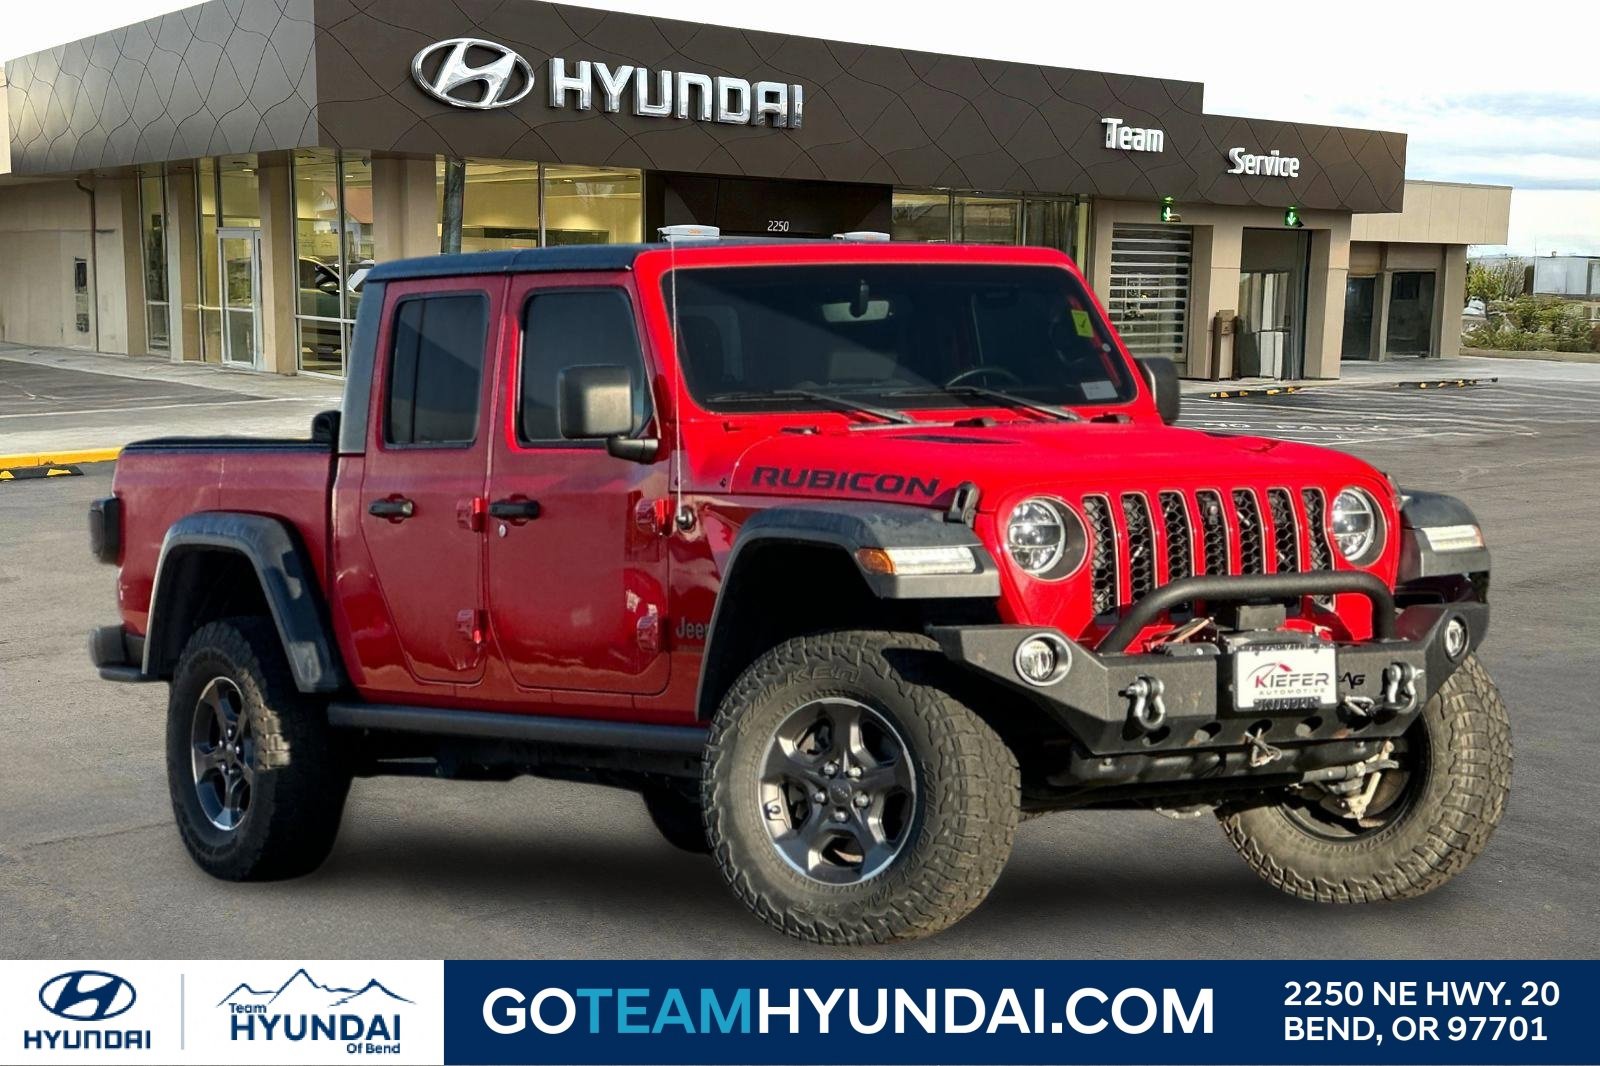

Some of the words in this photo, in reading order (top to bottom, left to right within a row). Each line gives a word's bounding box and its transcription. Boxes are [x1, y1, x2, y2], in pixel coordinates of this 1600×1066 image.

[549, 56, 803, 129] HYUNDAI
[1101, 117, 1165, 153] Team
[1227, 146, 1301, 179] Service
[767, 220, 790, 232] 2250
[752, 465, 940, 497] RUBICON
[1253, 671, 1329, 689] KIEFER
[1259, 688, 1326, 696] AUTOMOTIVE
